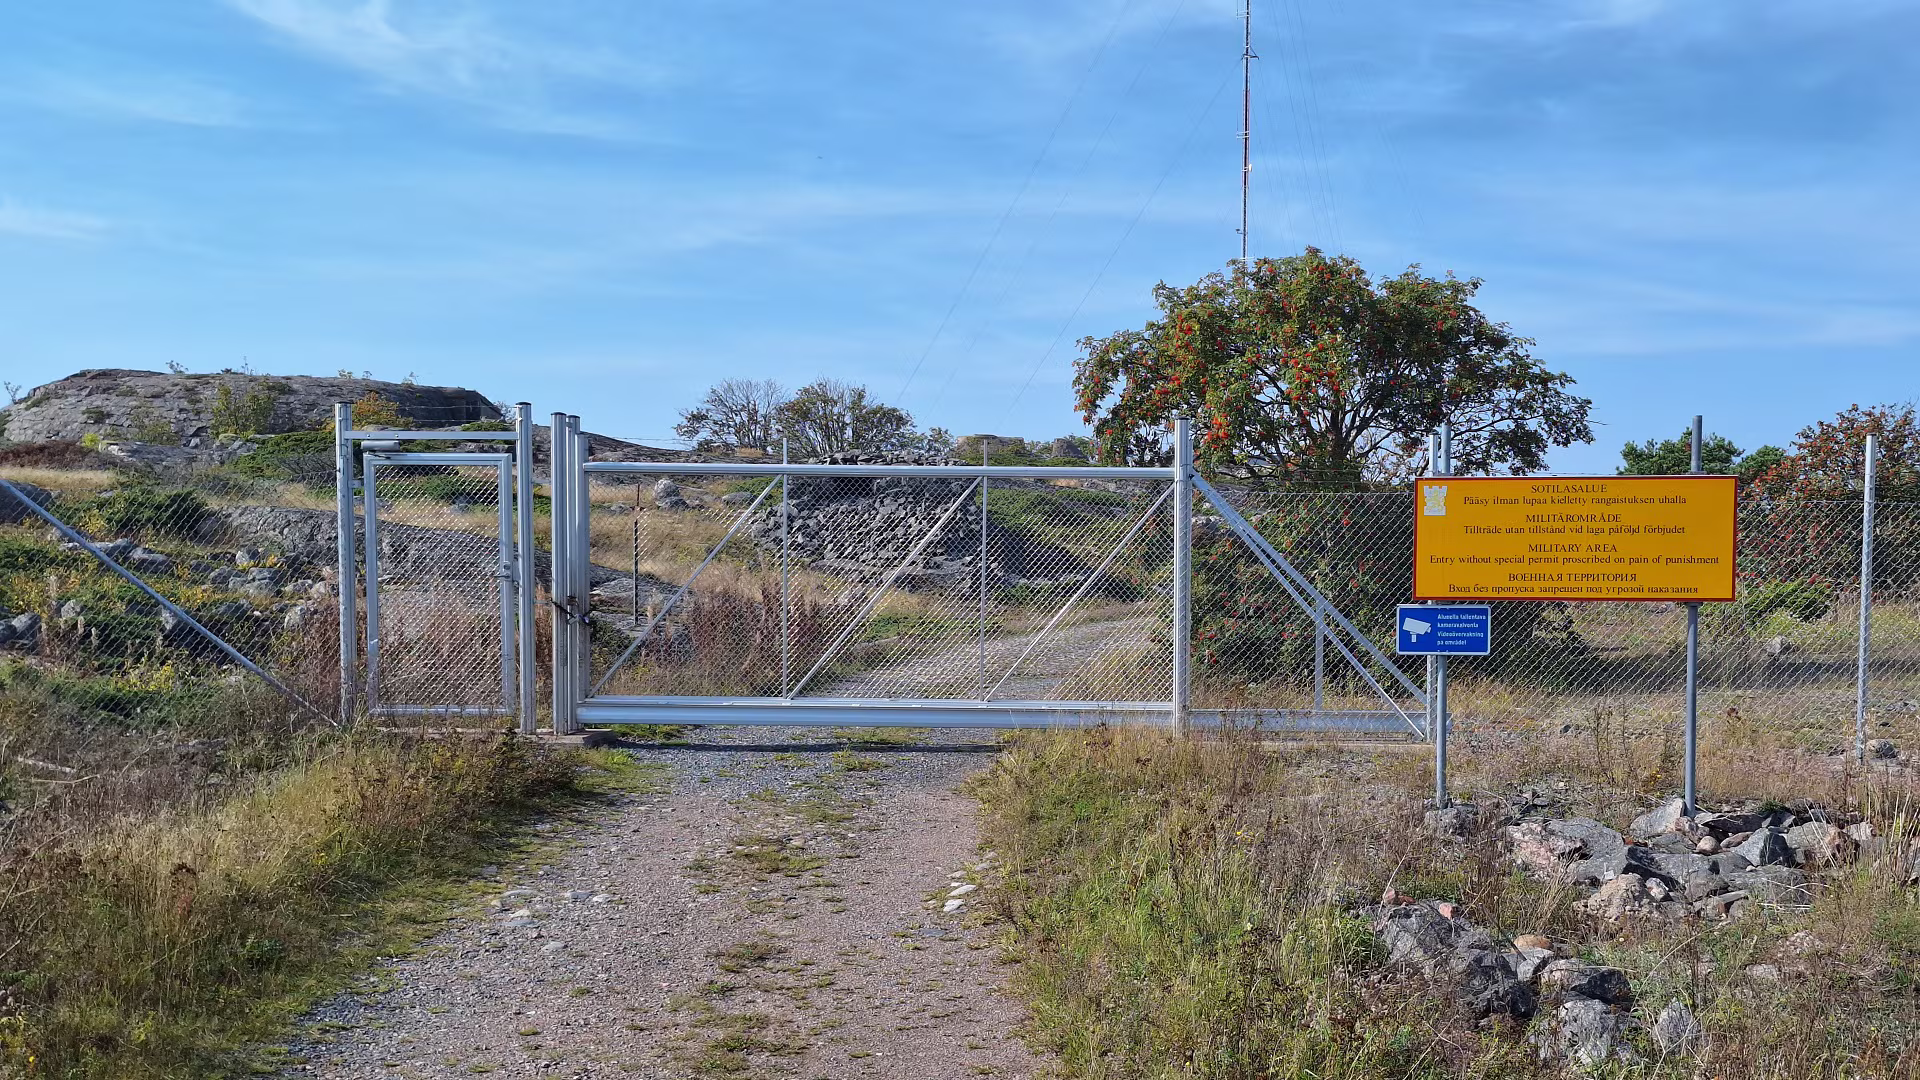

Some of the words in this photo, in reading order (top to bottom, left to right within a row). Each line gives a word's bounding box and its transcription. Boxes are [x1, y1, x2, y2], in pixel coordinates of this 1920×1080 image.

[1531, 484, 1607, 492] SOTILASALUE
[1464, 497, 1489, 506] Pääsy
[1493, 495, 1519, 504] ilman
[1523, 496, 1547, 506] lupaa
[1551, 496, 1587, 506] kielletty
[1592, 495, 1654, 506] rangaistuksen
[1659, 495, 1686, 504] uhalla
[1526, 512, 1621, 522] MILITÄROMRÅDE
[1464, 525, 1502, 534] Tillträde
[1529, 524, 1565, 533] tillstånd
[1569, 524, 1582, 533] vid
[1587, 525, 1605, 535] laga
[1609, 525, 1639, 535] påföljd
[1644, 525, 1685, 535] förbjudet
[1529, 544, 1581, 552] MILITARY
[1586, 544, 1617, 552] AREA
[1431, 555, 1455, 565] Entry
[1459, 554, 1491, 563] without
[1494, 555, 1524, 565] special
[1529, 555, 1558, 565] permit
[1563, 555, 1610, 565] proscribed
[1629, 555, 1648, 565] pain
[1652, 554, 1662, 563] of
[1666, 555, 1719, 565] punishment
[1509, 573, 1562, 581] ВОЕННАЯ
[1566, 573, 1636, 581] ТЕРРИТОРИЯ
[1449, 583, 1470, 593] Вход
[1474, 583, 1488, 593] без
[1492, 586, 1534, 595] пропуска
[1538, 586, 1582, 595] запрещен
[1587, 586, 1602, 594] под
[1606, 585, 1644, 596] угрозой
[1648, 586, 1698, 594] наказания
